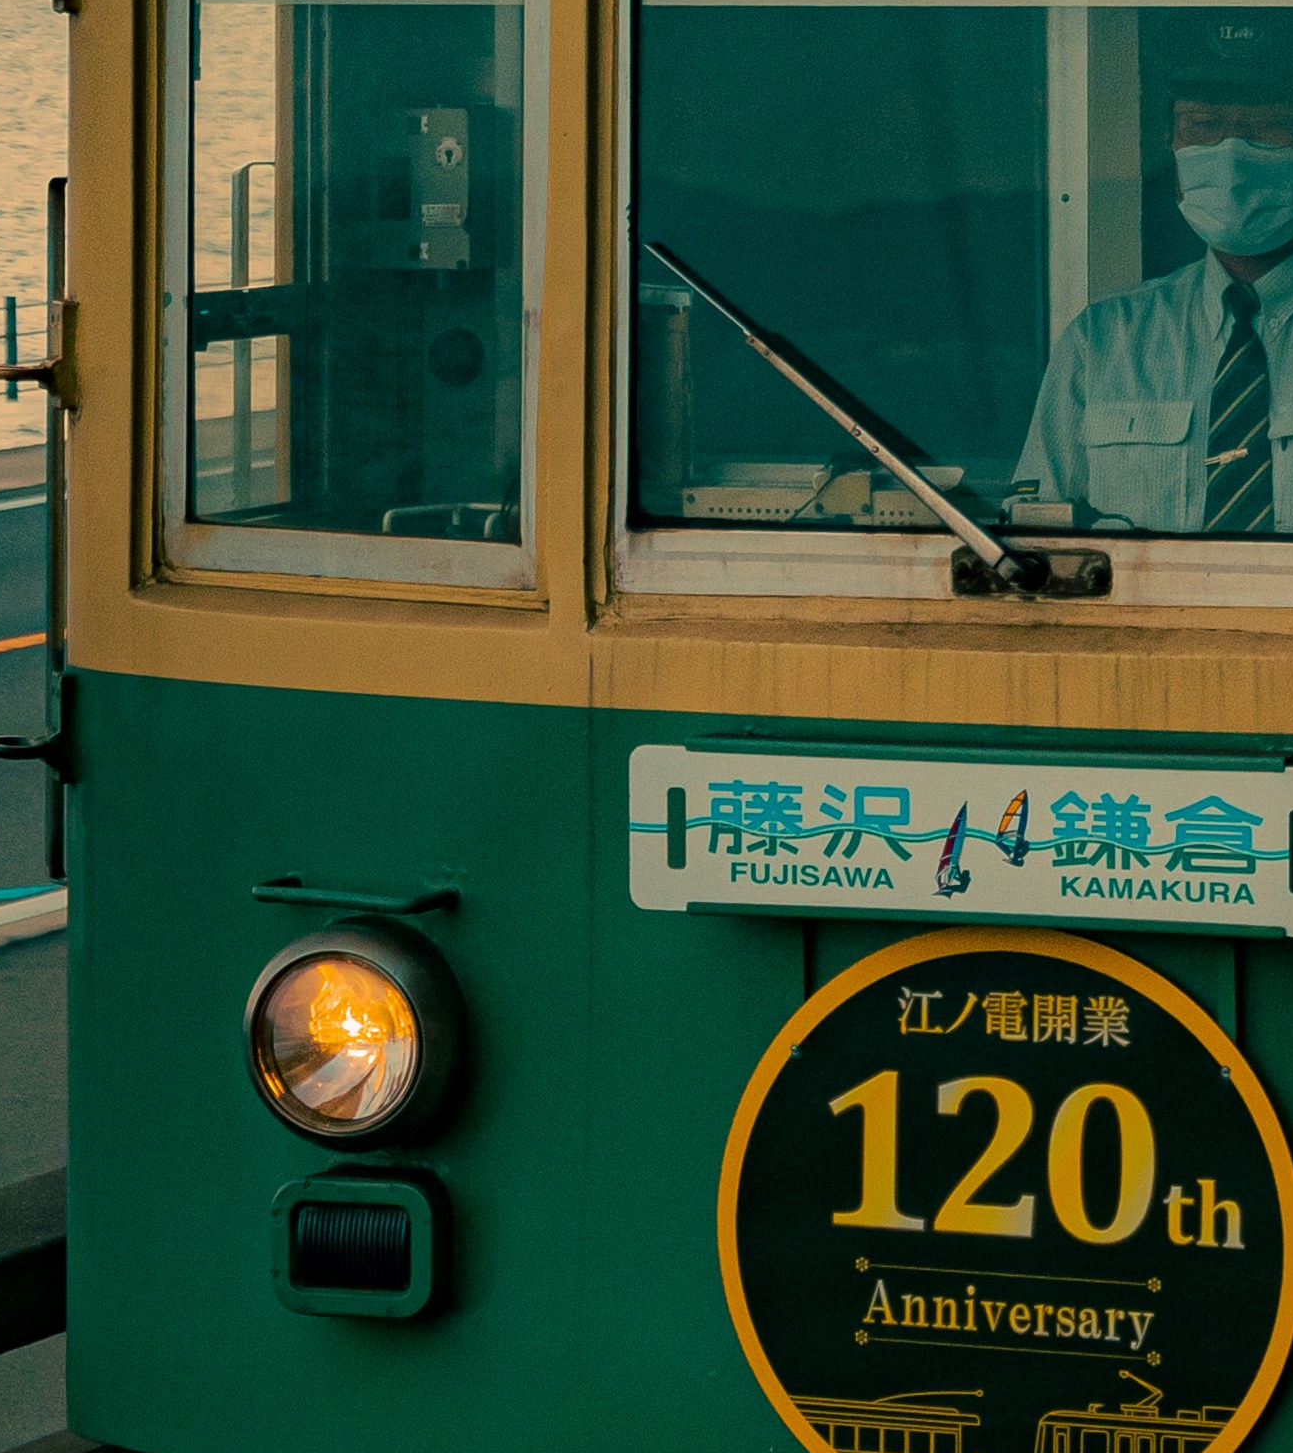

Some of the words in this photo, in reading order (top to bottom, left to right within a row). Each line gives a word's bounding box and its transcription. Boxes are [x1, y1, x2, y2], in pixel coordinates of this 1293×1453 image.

[708, 779, 913, 862] 藤沢
[1050, 790, 1264, 875] 鎌倉
[730, 862, 895, 889] FUJISAWA
[1060, 876, 1256, 905] KAMAKURA
[897, 986, 1131, 1047] 江ノ電開業
[828, 1069, 1245, 1250] 120th
[862, 1278, 1154, 1350] Anniversary
